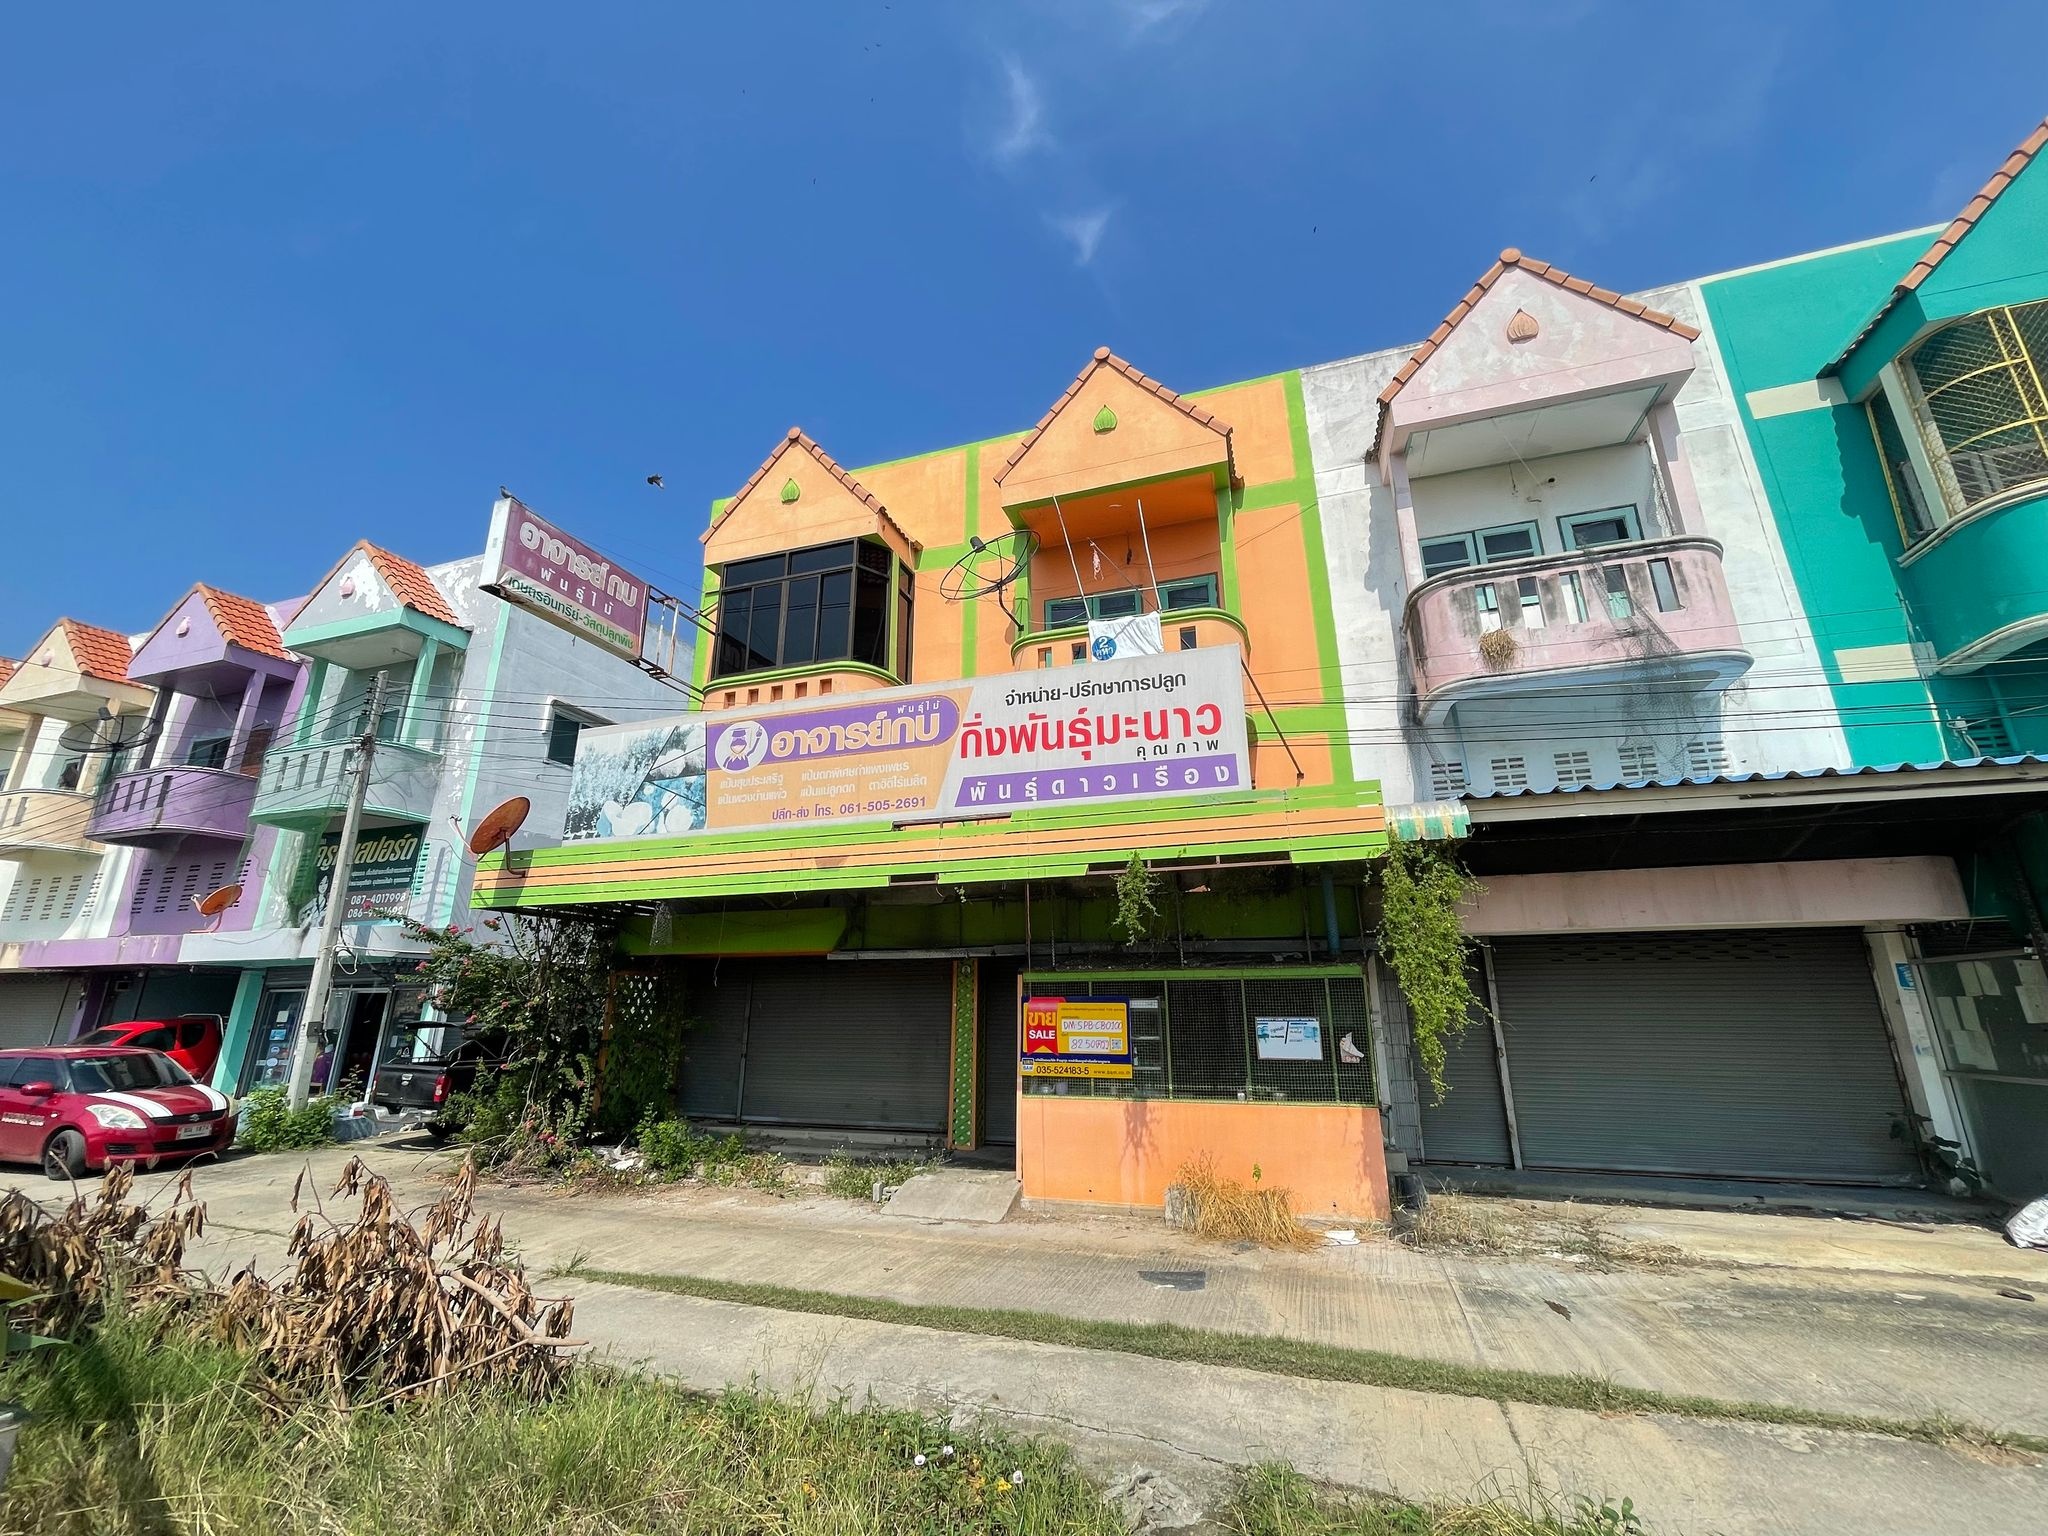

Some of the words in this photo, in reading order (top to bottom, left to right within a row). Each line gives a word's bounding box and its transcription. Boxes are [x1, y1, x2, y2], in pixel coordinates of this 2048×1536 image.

[519, 521, 638, 608] อาจารย์กบ
[1005, 671, 1187, 706] จำหน่าย-ปรึกษาการปลูก
[771, 711, 941, 758] อาจารย์กบ
[959, 702, 1223, 761] กิ่งพันธุ์มะนาว
[1136, 740, 1219, 761] คุณภาพ
[970, 764, 1230, 801] พันธุ์ดาวเรือง
[815, 804, 834, 817] โทร.
[839, 796, 926, 815] 061-505-2691
[1028, 1011, 1056, 1027] ขาย
[1029, 1029, 1056, 1040] SALE
[1036, 1065, 1090, 1075] 035-524183-5
